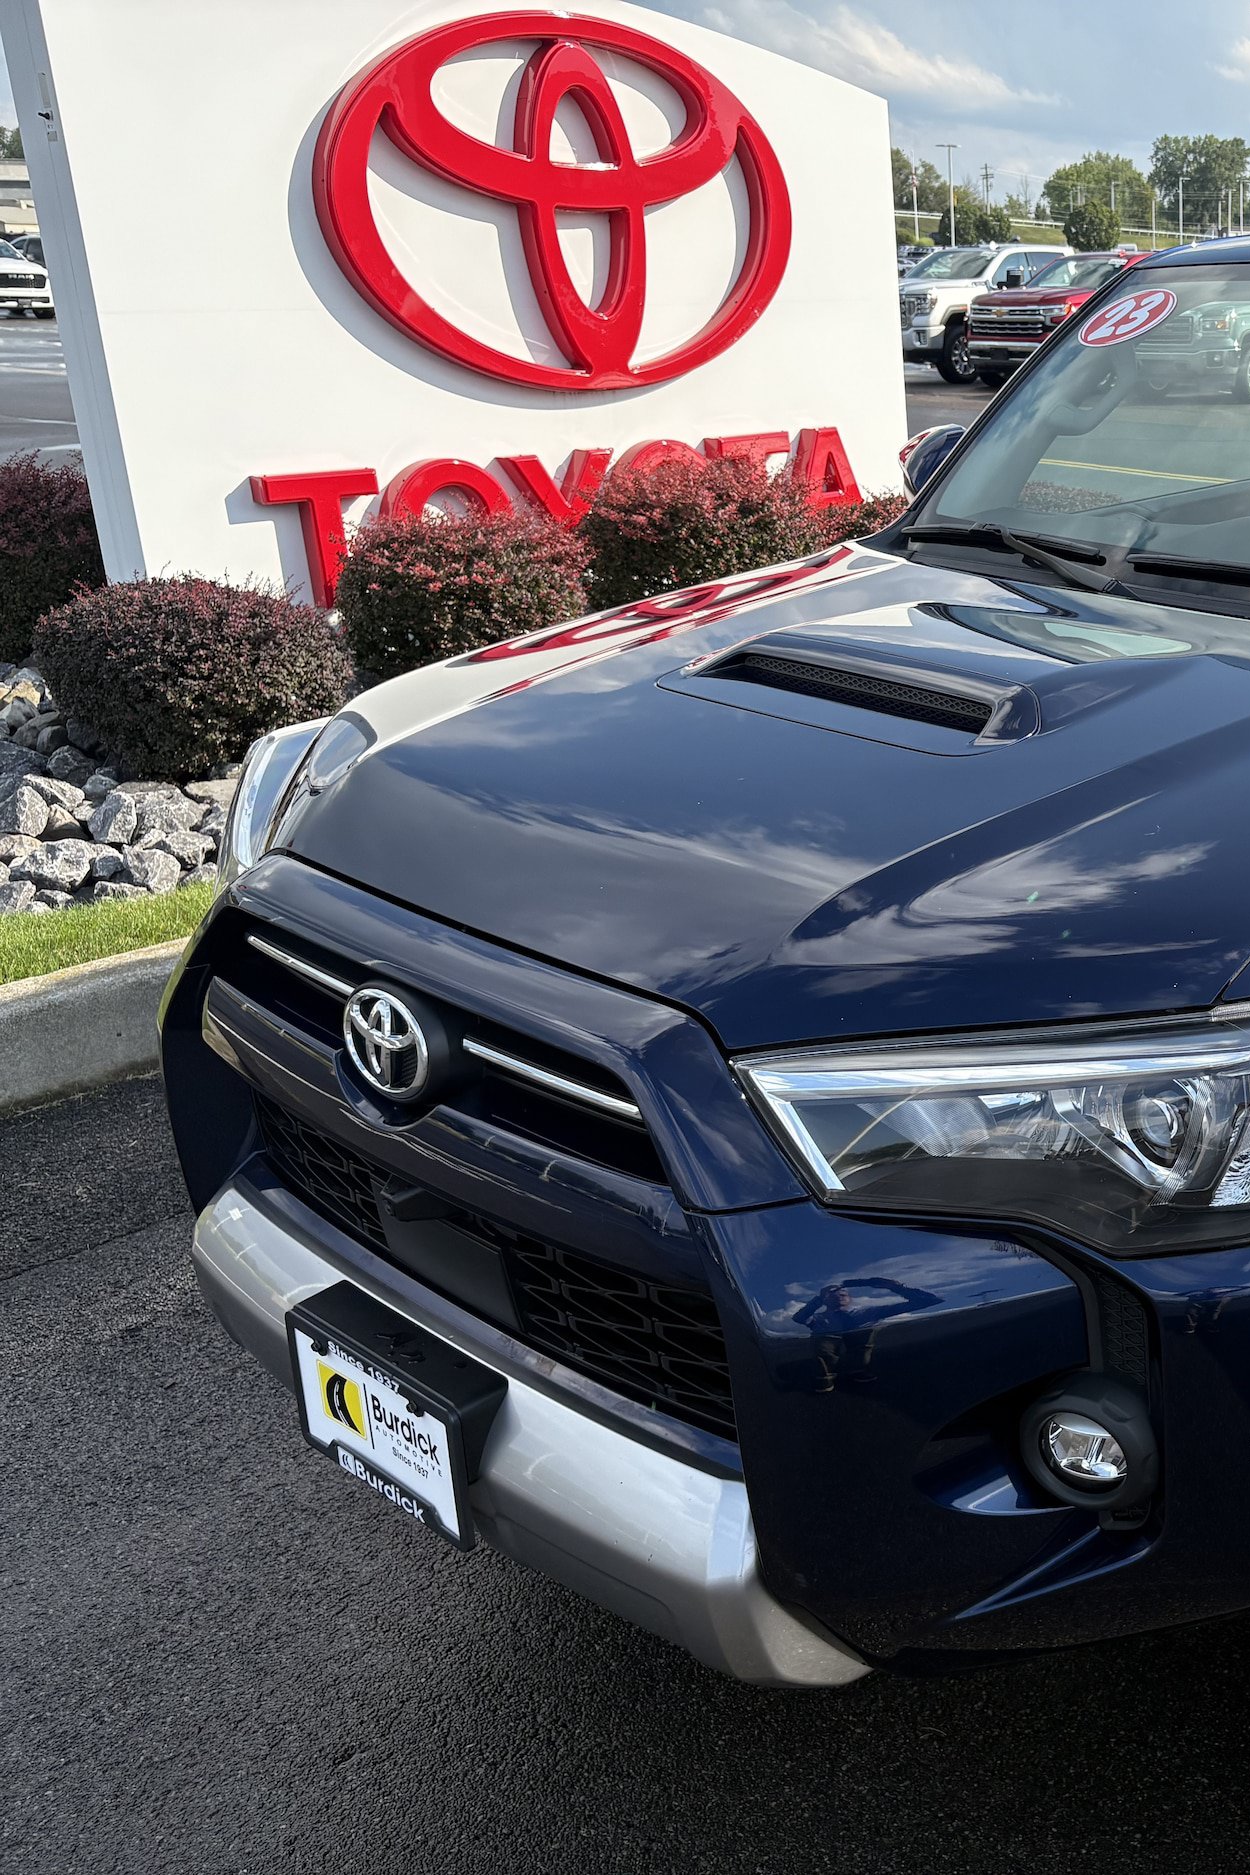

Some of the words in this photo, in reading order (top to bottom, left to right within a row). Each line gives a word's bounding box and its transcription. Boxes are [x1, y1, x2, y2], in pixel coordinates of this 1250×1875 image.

[1086, 292, 1165, 341] 23
[251, 427, 864, 608] TOYTA
[327, 1340, 365, 1372] Since
[367, 1366, 400, 1395] 1937
[371, 1393, 441, 1466] Burdick
[375, 1425, 443, 1478] AUTOMOTIVE
[392, 1446, 412, 1467] Since
[413, 1461, 429, 1479] 1937
[355, 1459, 425, 1524] Burdick
